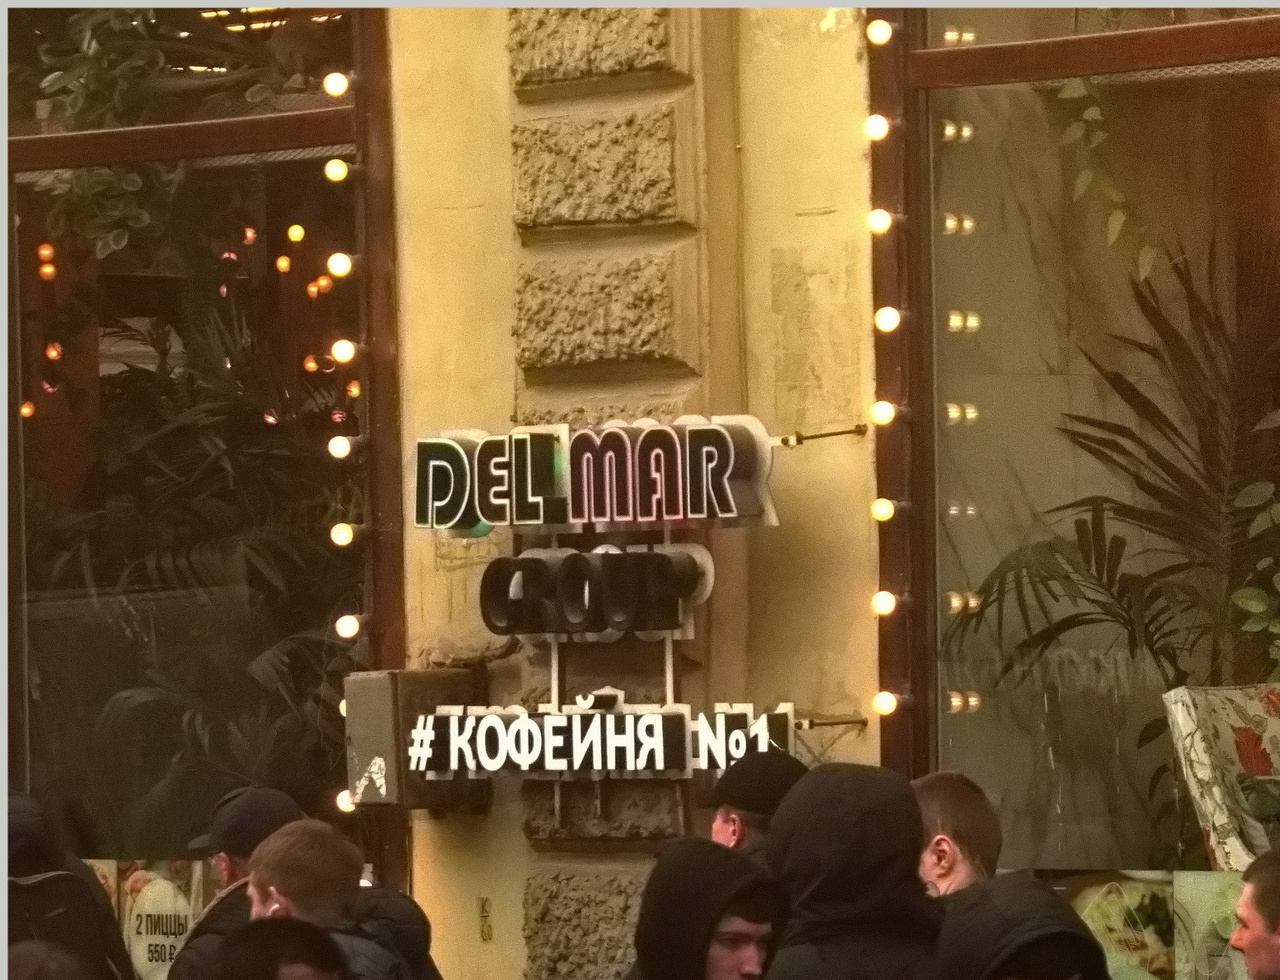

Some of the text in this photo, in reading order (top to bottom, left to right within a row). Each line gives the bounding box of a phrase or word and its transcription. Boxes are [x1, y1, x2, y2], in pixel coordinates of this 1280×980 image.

[414, 424, 738, 529] DEL MAR
[450, 693, 665, 771] КОФЕЙНЯ
[136, 913, 188, 938] 2 ПИЦЦЫ
[148, 944, 166, 962] 550
